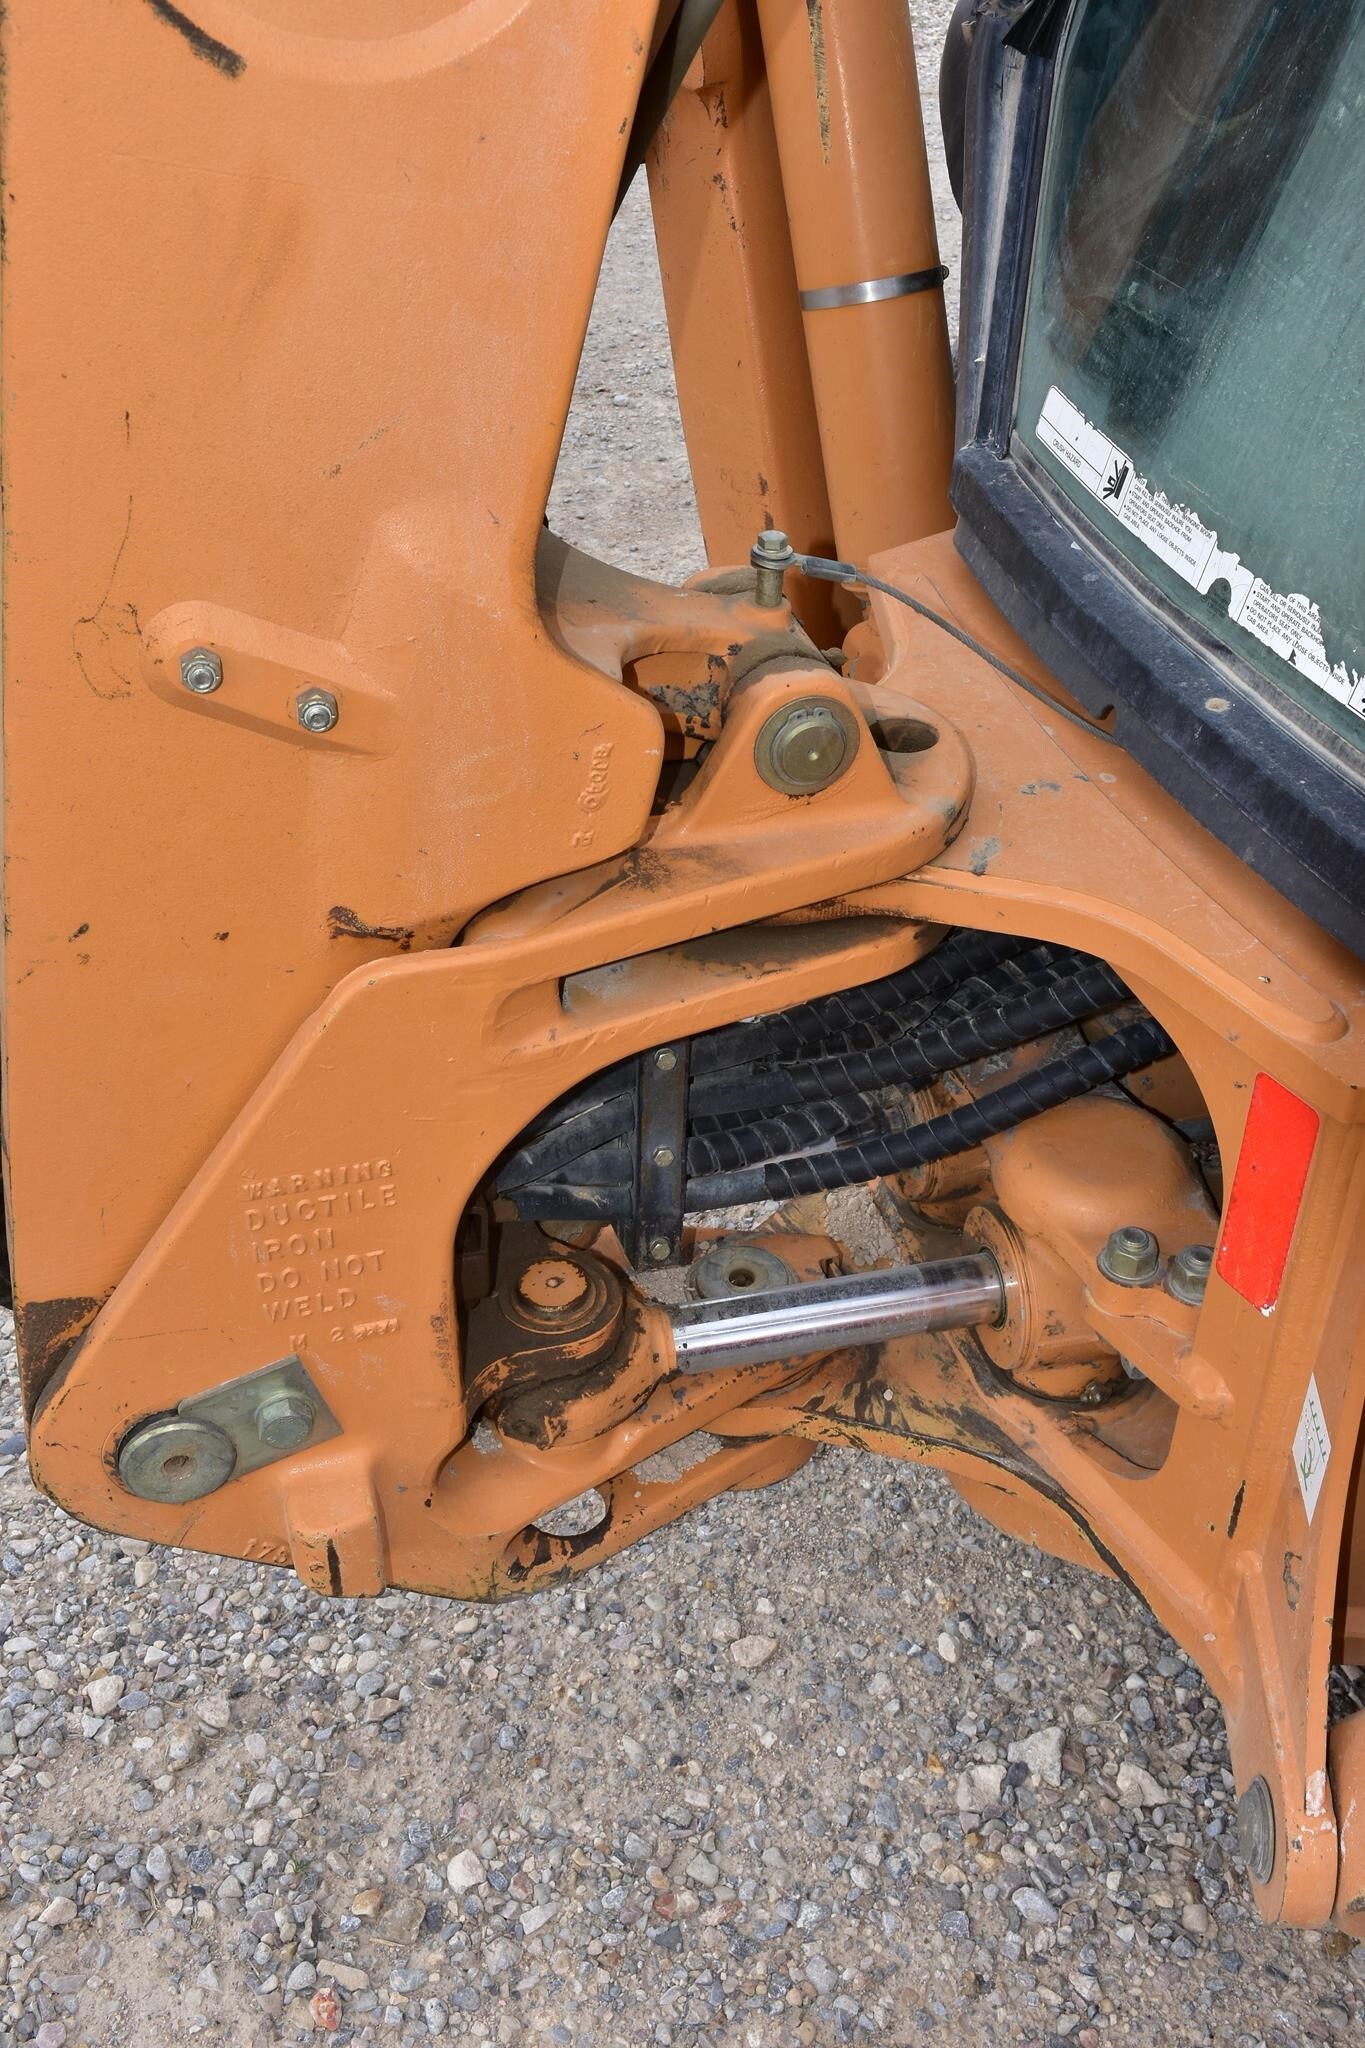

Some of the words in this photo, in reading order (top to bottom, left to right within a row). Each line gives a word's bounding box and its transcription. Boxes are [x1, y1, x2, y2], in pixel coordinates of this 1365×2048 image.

[1053, 439, 1066, 454] CRUSH
[1065, 450, 1082, 468] HAZARD
[1123, 512, 1132, 522] CAB
[1129, 498, 1148, 517] OPERATORS
[1147, 513, 1156, 523] SEAT
[1131, 491, 1142, 502] START
[1142, 500, 1150, 509] AND
[1150, 506, 1165, 521] OPERATE
[1164, 518, 1181, 534] BACKHOE
[1181, 531, 1192, 543] FROM
[1134, 484, 1142, 492] CAN
[1141, 490, 1149, 499] KILL
[1154, 500, 1171, 517] SERIOUSLY
[1172, 514, 1184, 527] INJURE
[1126, 505, 1132, 513] DO
[1138, 515, 1149, 527] PLACE
[1157, 531, 1168, 543] LOOSE
[1168, 541, 1185, 557] OBJECTS
[1184, 554, 1197, 567] INSIDE
[1246, 615, 1256, 625] CAB
[1253, 599, 1278, 622] OPERATORS
[1279, 619, 1290, 631] SEAT
[1256, 592, 1270, 605] START
[1271, 603, 1281, 614] AND
[1281, 611, 1301, 629] OPERATE
[1260, 584, 1270, 595] CAN
[1280, 599, 1287, 608] OR
[1287, 605, 1309, 626] SERIOUSLY
[1289, 596, 1296, 604] OF
[1297, 602, 1307, 613] THIS
[1250, 607, 1257, 616] DO
[1257, 612, 1266, 623] NOT
[1267, 620, 1280, 634] PLACE
[1282, 632, 1291, 643] ANY
[1292, 640, 1308, 656] LOOSE
[1308, 652, 1329, 673] OBJECTS
[244, 1159, 393, 1200] WARNING
[245, 1184, 398, 1231] DUCTILE
[252, 1228, 335, 1263] IRON
[257, 1266, 301, 1293] DO
[321, 1249, 385, 1281] NOT
[262, 1288, 359, 1323] WELD
